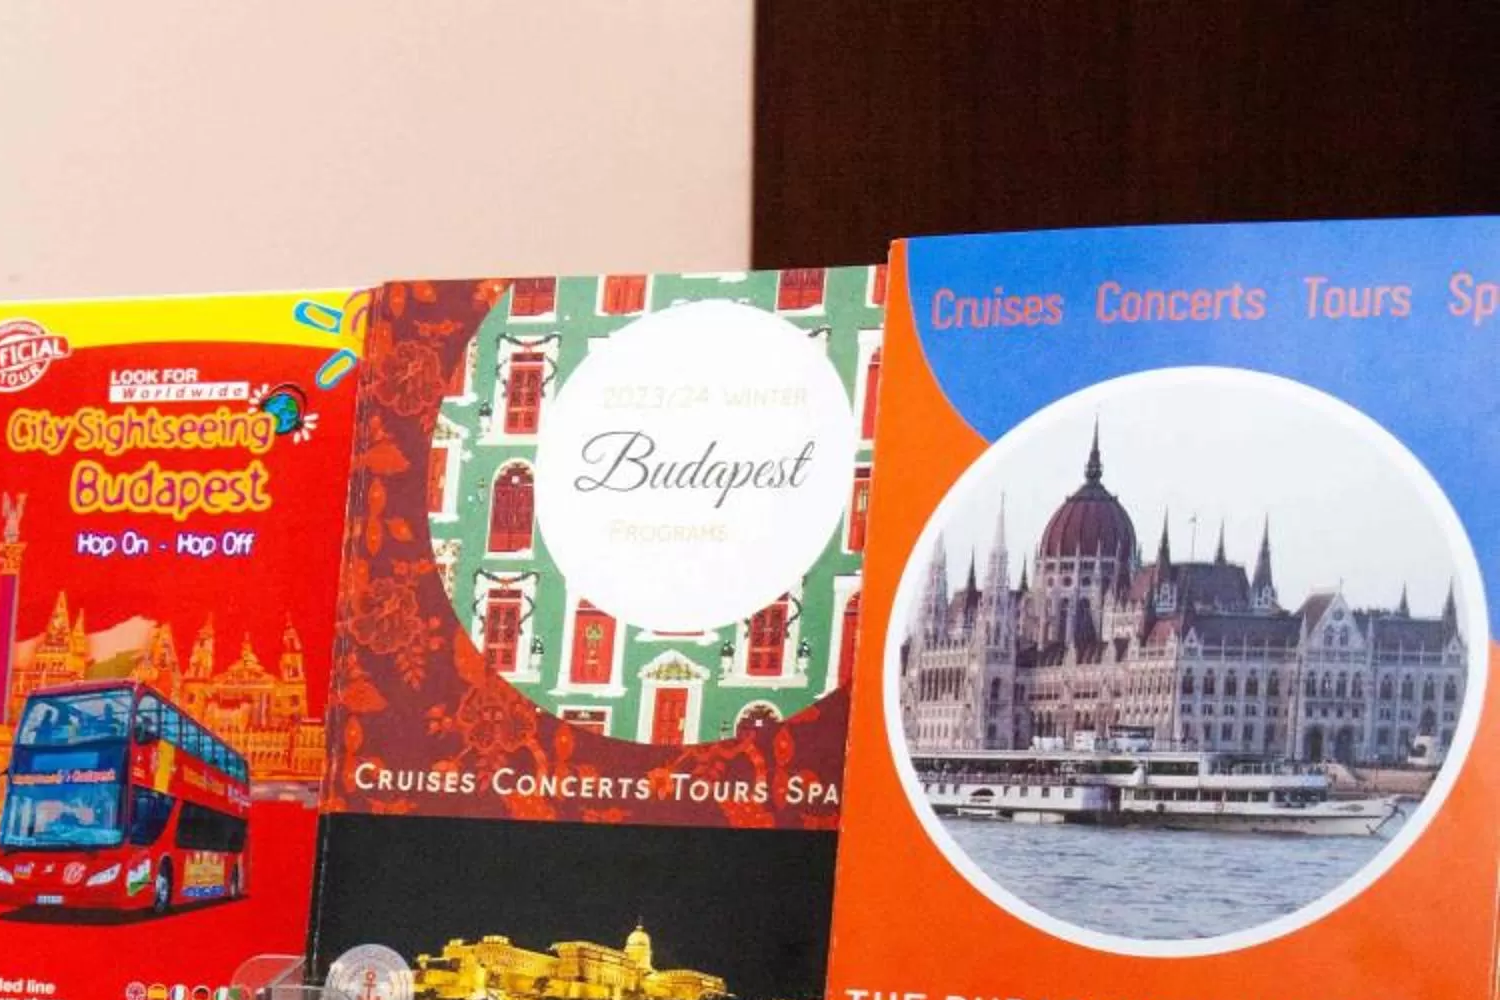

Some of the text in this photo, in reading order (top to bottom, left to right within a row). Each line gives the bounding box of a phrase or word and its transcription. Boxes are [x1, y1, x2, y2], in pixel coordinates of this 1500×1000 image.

[932, 286, 1063, 330] Cruises
[1096, 281, 1266, 324] Concerts
[1304, 275, 1412, 319] Tours
[0, 364, 41, 387] TOUR
[110, 368, 198, 385] LOOK FOR
[121, 384, 244, 400] Worldwide
[7, 404, 275, 456] City Sightseeing
[573, 430, 816, 509] Budapest
[71, 460, 271, 521] Budapest
[78, 532, 116, 556] Hop
[121, 532, 149, 554] On
[177, 532, 216, 556] Hop
[222, 531, 253, 554] Off
[355, 763, 840, 805] CRUISES CONCERTS TOURS SPA
[27, 979, 56, 994] line
